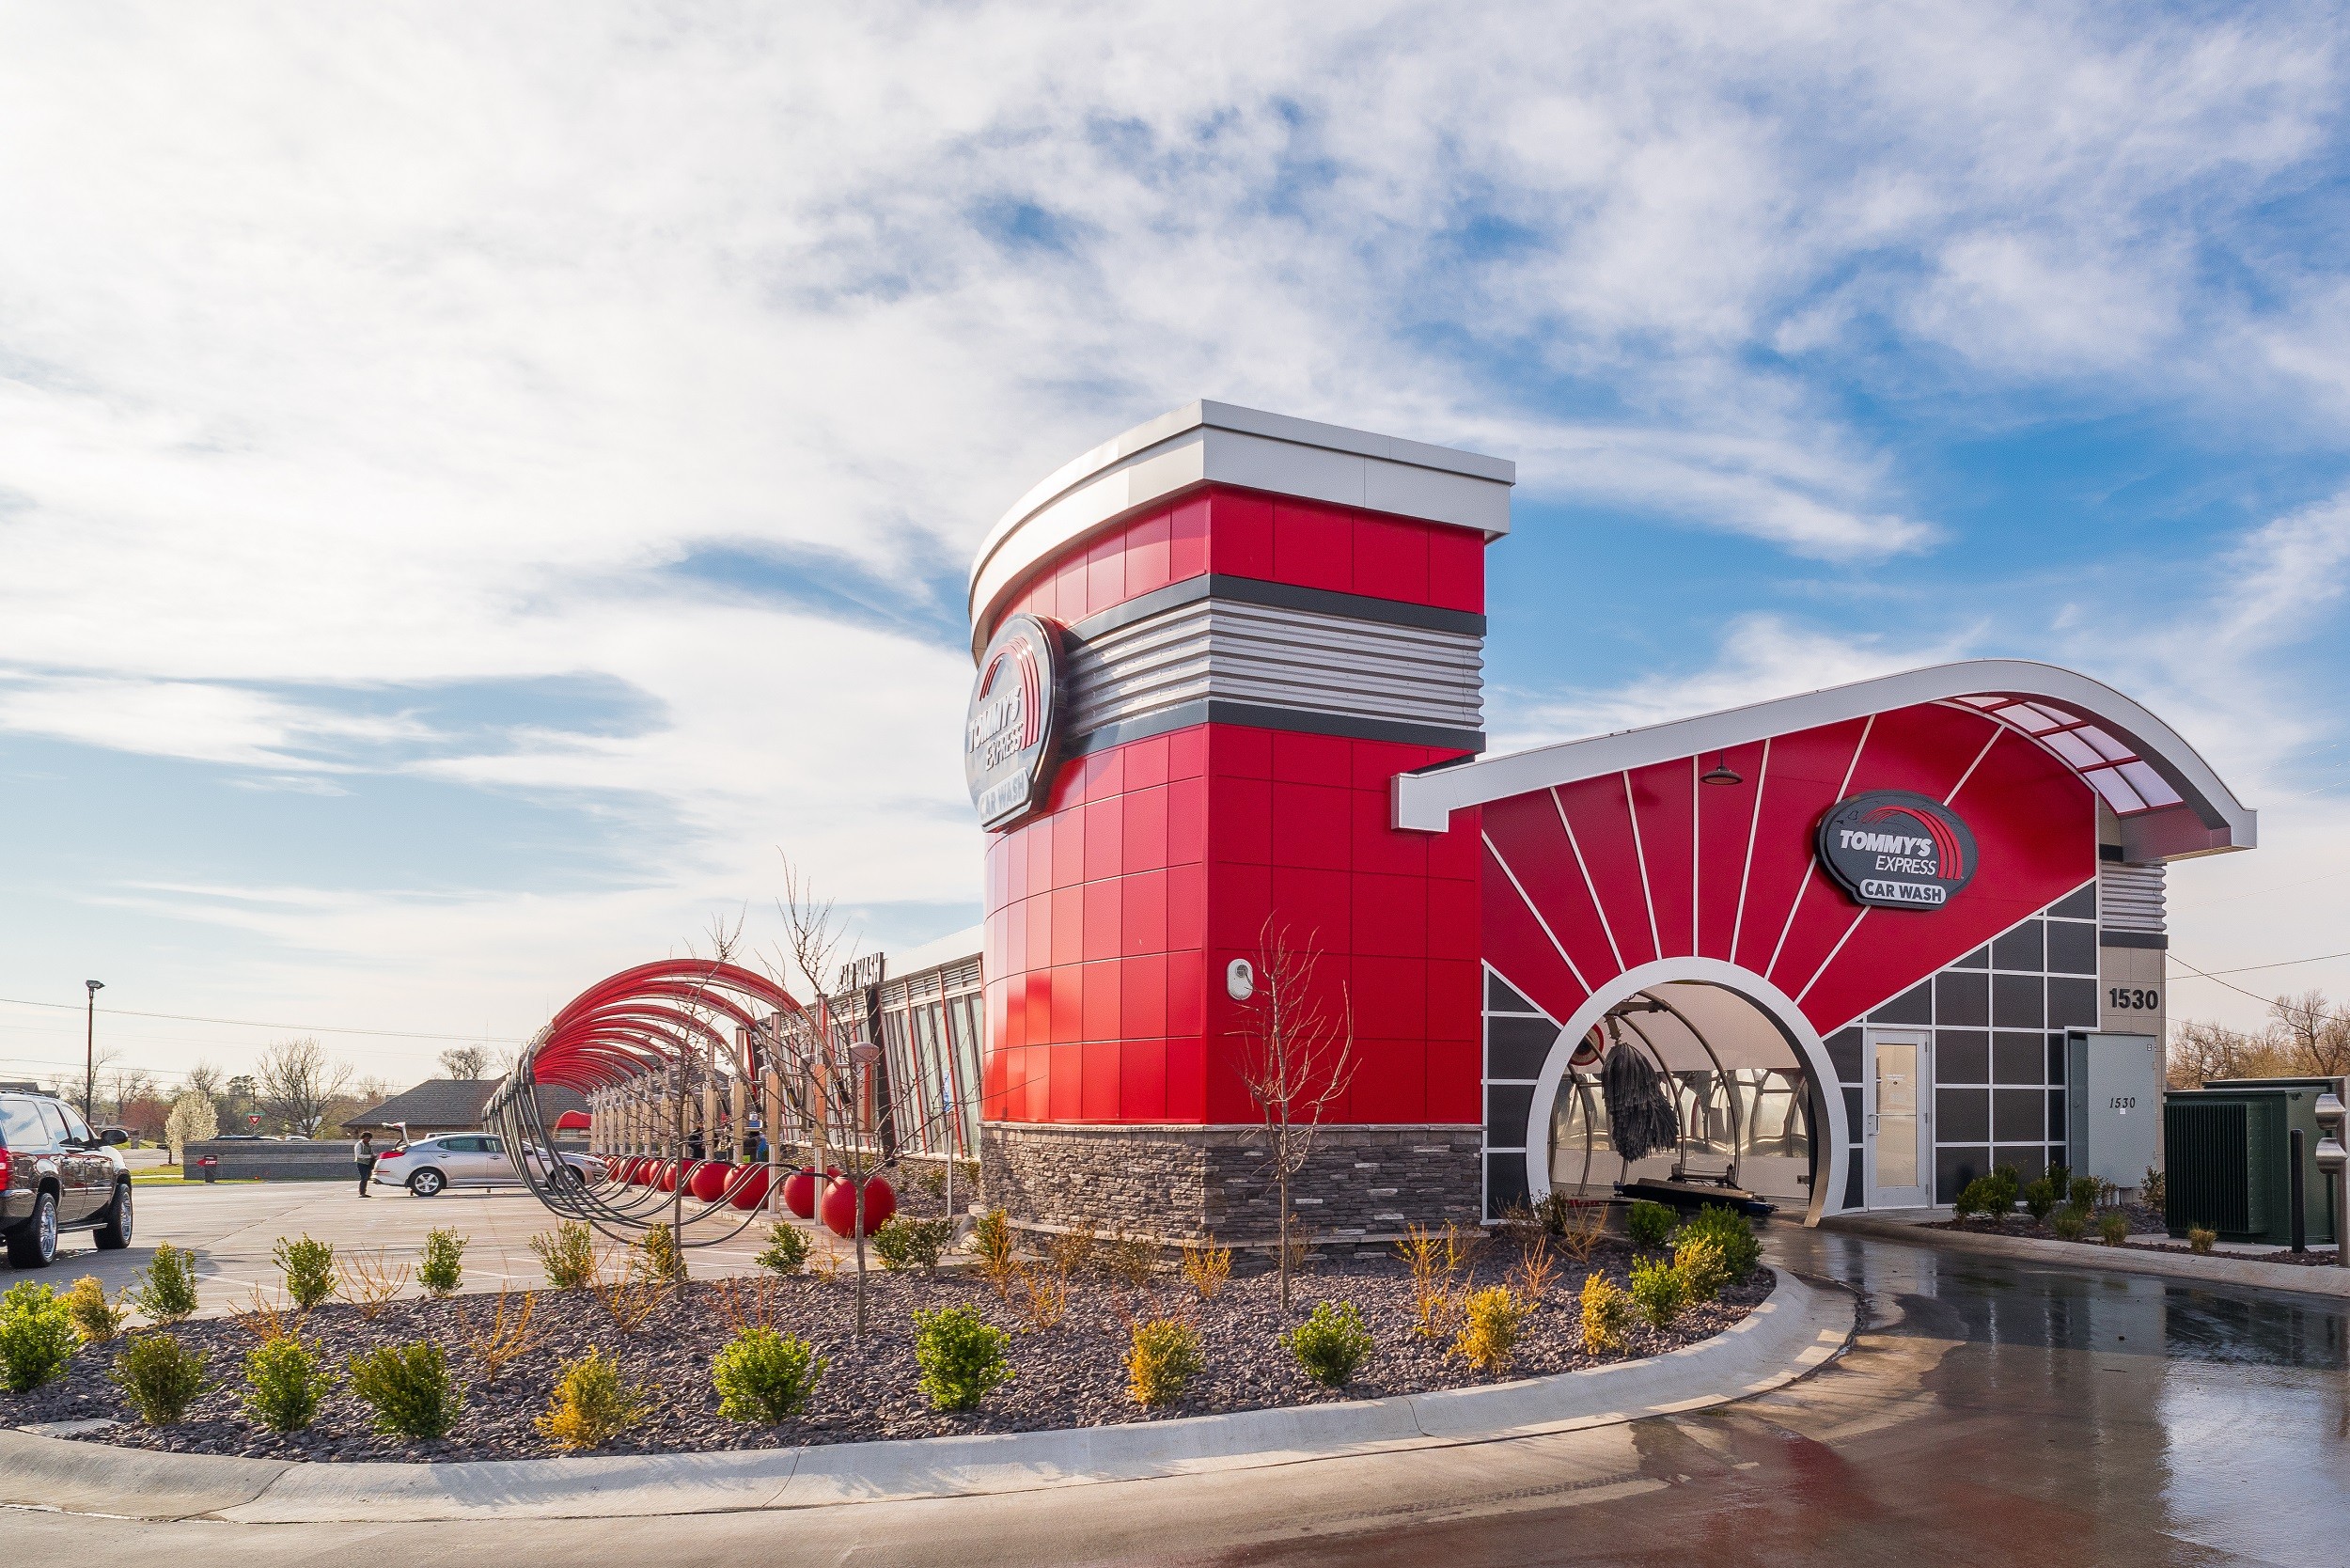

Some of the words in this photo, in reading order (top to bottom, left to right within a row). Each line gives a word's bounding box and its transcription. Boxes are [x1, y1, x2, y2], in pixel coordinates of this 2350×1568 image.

[969, 685, 1022, 753] TOMMY'S
[985, 721, 1024, 771] EXPRESS
[980, 792, 996, 820] CAR
[998, 774, 1025, 809] WASH
[1840, 830, 1933, 857] TOMMY'S
[1875, 855, 1936, 876] EXPRESS
[1865, 882, 1895, 897] CAR
[1899, 885, 1942, 902] WASH
[856, 952, 884, 988] WASH
[2109, 988, 2158, 1010] 1530
[2109, 1097, 2136, 1108] 1530
